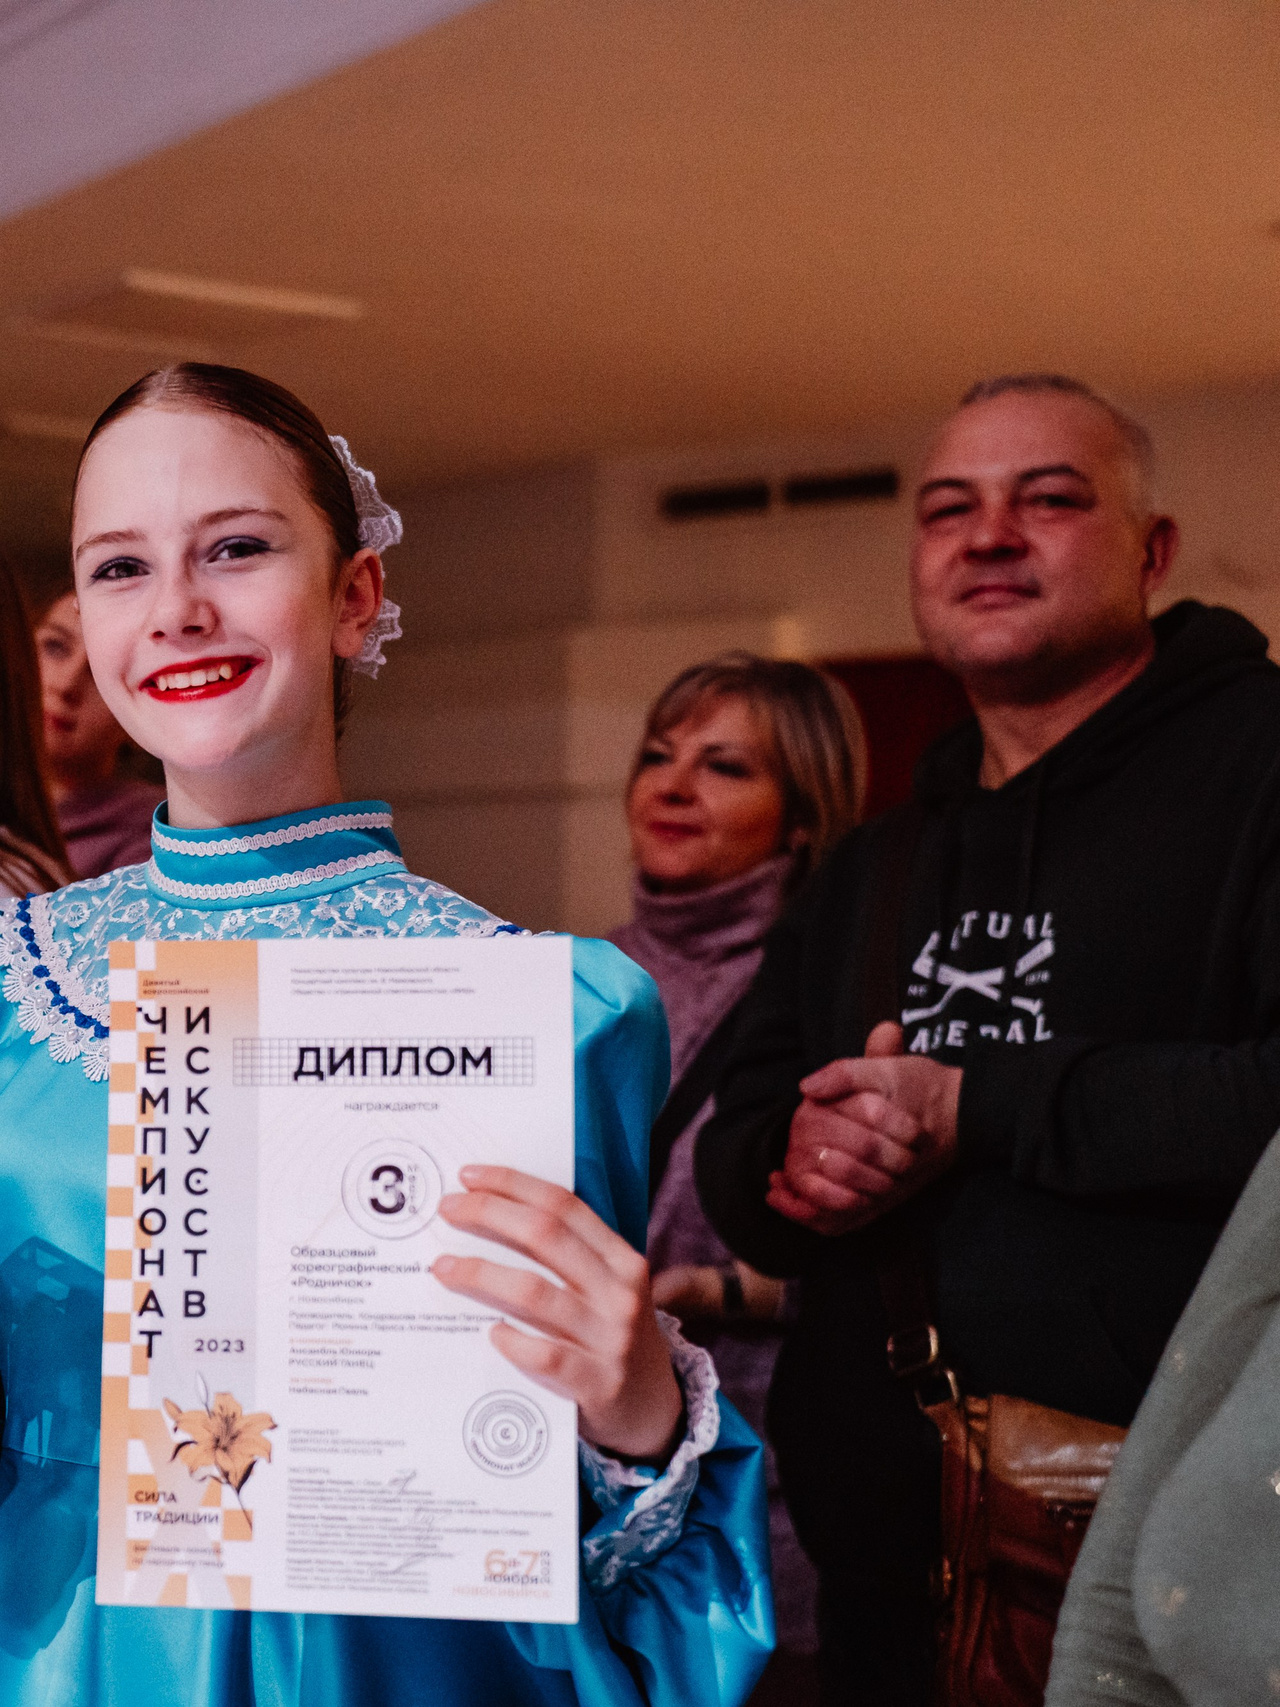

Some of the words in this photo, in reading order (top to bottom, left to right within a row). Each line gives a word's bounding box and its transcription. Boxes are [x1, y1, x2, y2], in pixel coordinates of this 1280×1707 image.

[293, 1046, 492, 1082] ДИПЛОМ
[344, 1101, 439, 1112] награждается
[183, 1006, 210, 1318] ИСКУССТВ
[136, 1006, 169, 1358] ЧЕМПИОНАТ
[370, 1164, 406, 1215] 3
[290, 1246, 376, 1258] Образцовый
[290, 1262, 421, 1275] хореографический
[291, 1277, 372, 1288] «Родничок»
[194, 1339, 245, 1352] 2023
[134, 1490, 178, 1504] СИЛА
[135, 1510, 220, 1525] ТРАДИЦИИ
